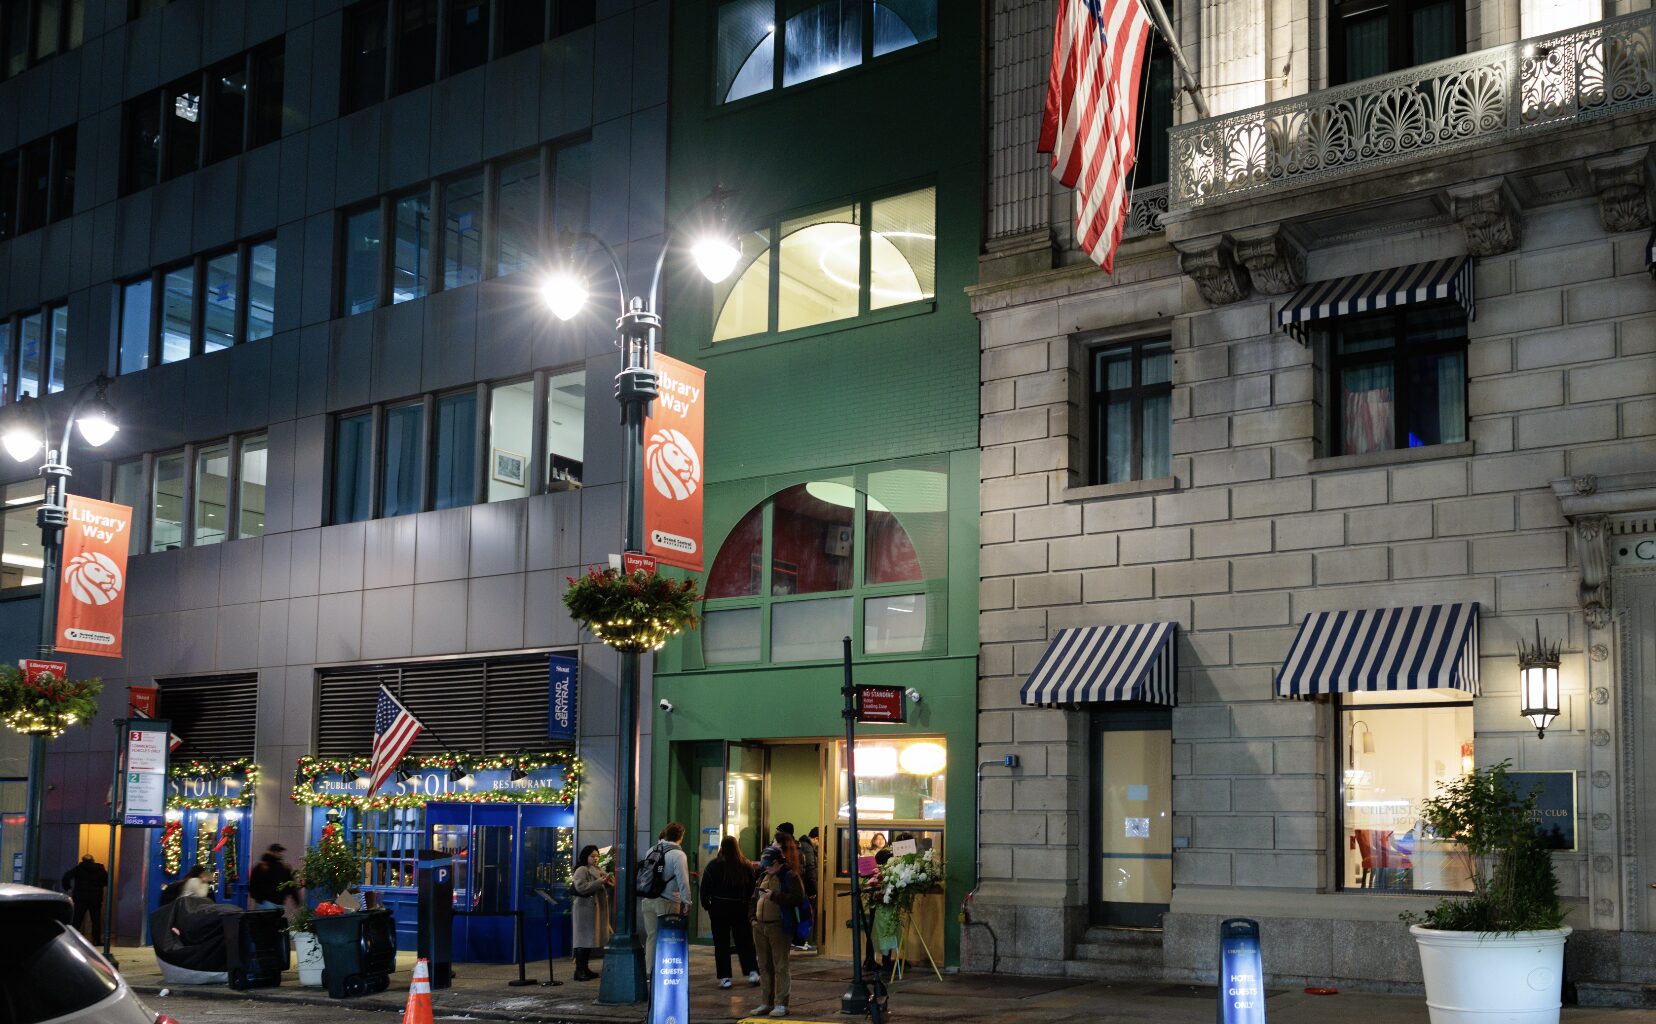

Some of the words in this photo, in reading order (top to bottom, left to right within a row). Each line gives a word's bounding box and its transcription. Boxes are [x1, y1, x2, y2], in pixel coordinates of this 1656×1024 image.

[659, 370, 699, 403] ibrary
[660, 392, 690, 418] Way
[72, 508, 126, 532] Library
[82, 525, 114, 545] Way
[627, 557, 643, 566] Library
[643, 559, 654, 568] Way
[29, 662, 50, 670] Library
[50, 663, 64, 671] Way
[560, 677, 569, 728] CENTRAL
[132, 732, 140, 741] 3
[130, 773, 138, 782] 2
[171, 777, 233, 797] STOUT
[325, 782, 353, 790] PUBLIC
[396, 773, 475, 797] STOUT
[493, 779, 553, 790] RESTAURANT
[1545, 809, 1569, 817] CLUB
[439, 869, 447, 882] P
[1228, 988, 1258, 996] GUESTS
[1234, 1001, 1254, 1009] ONLY
